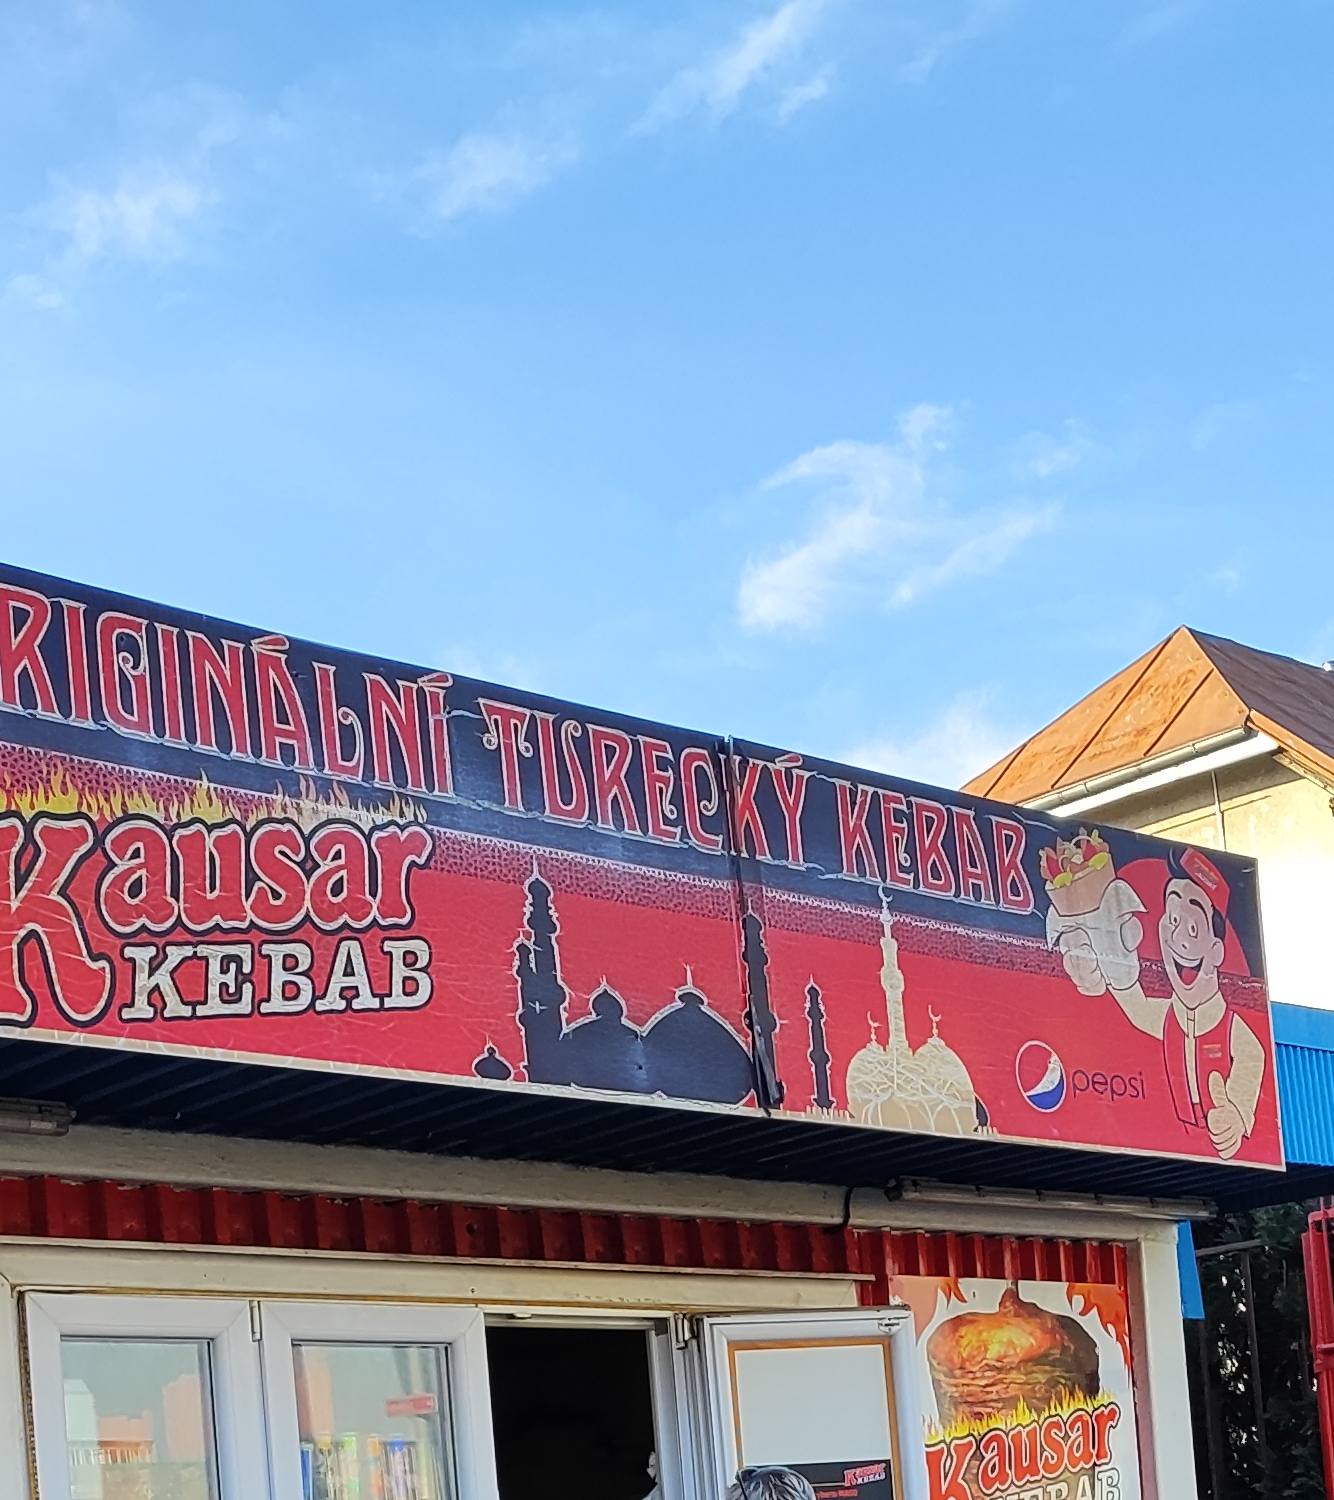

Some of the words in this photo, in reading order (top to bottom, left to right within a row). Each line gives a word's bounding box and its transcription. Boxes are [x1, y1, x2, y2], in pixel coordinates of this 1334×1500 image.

[476, 697, 812, 871] TURECKÝ
[835, 780, 1036, 915] KEBAB
[120, 938, 433, 1022] KEBAB
[1071, 1069, 1146, 1101] pepsi
